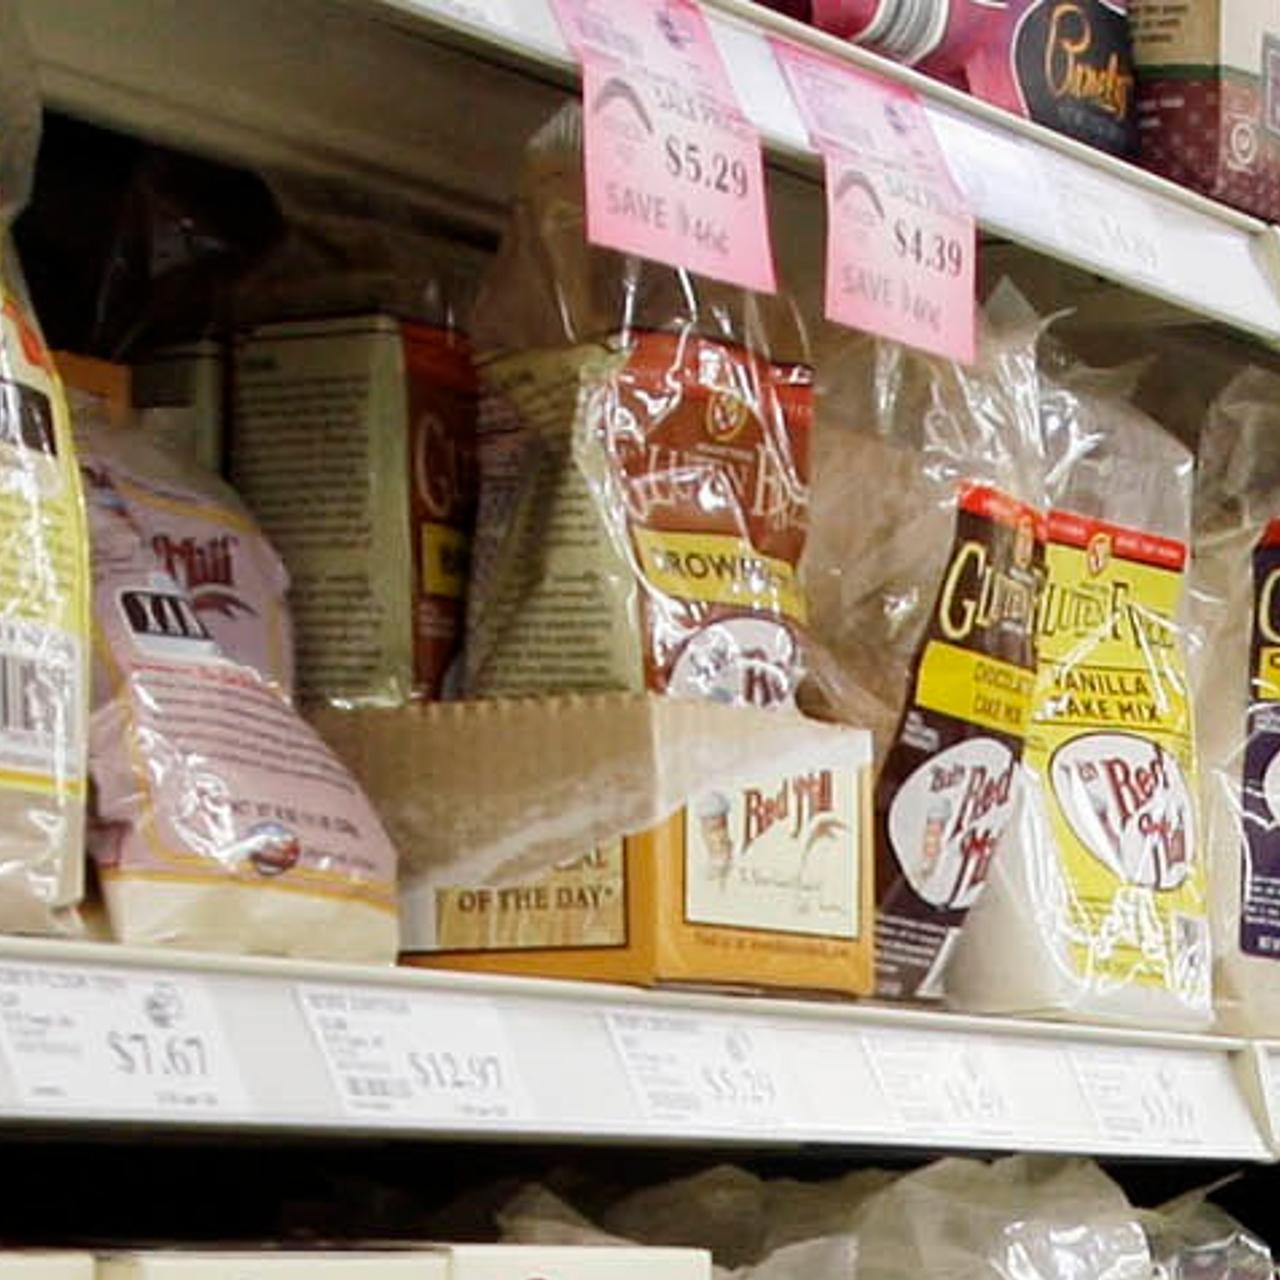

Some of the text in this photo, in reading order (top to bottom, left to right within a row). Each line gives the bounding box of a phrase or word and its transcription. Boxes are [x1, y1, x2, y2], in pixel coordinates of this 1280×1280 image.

[662, 138, 750, 198] $5.29
[604, 184, 668, 225] SAVE
[891, 219, 964, 277] $4.39
[843, 266, 896, 306] SAVE
[1119, 701, 1163, 723] MIX
[458, 886, 548, 914] OF THE
[106, 1032, 211, 1080] $7.67
